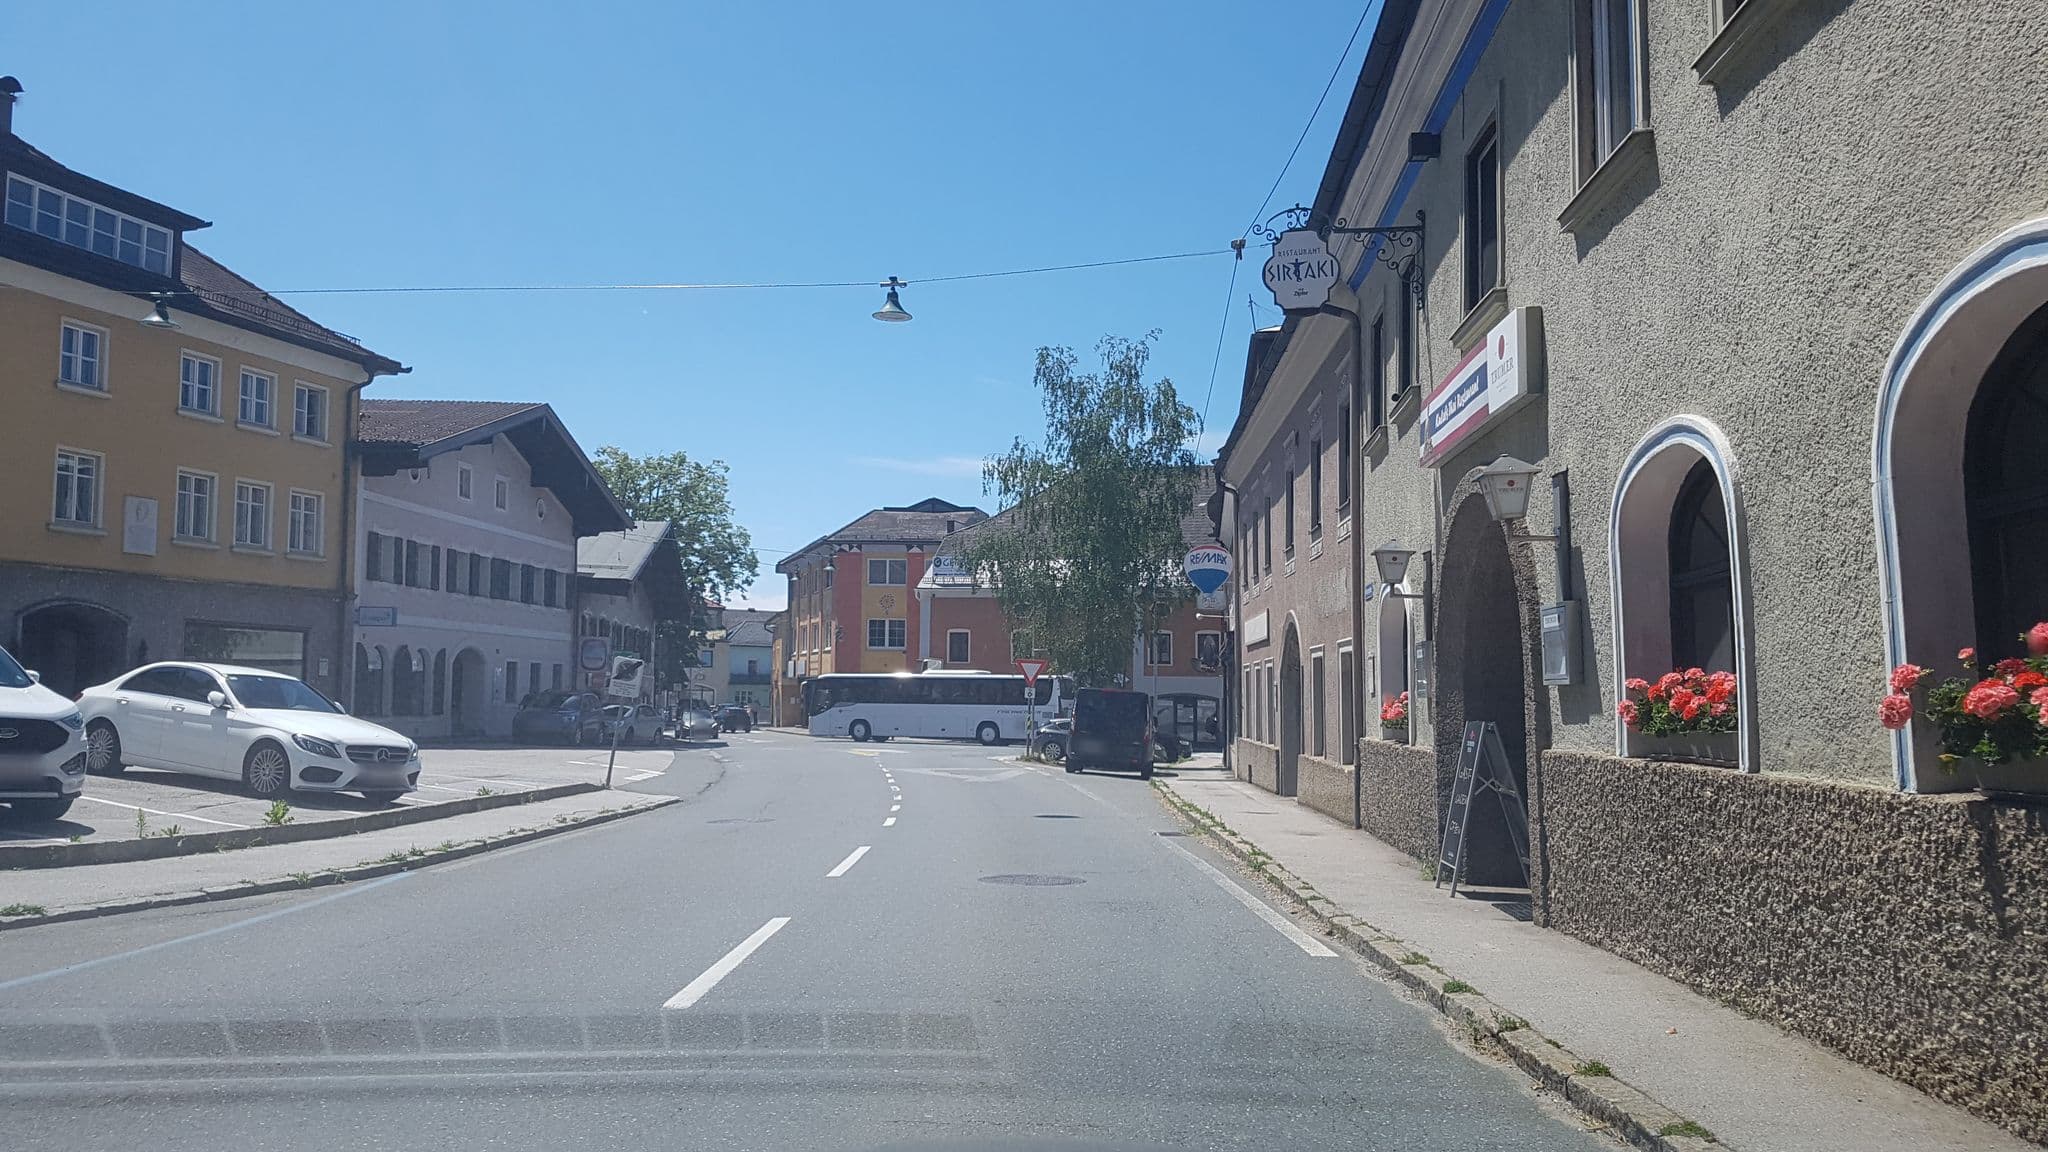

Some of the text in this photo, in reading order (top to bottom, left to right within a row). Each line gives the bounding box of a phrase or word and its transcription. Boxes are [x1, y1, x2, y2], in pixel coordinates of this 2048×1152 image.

[1278, 247, 1321, 257] RESTAURANT
[1267, 259, 1334, 282] SIRTAKI
[1190, 552, 1227, 565] RE/MAX
